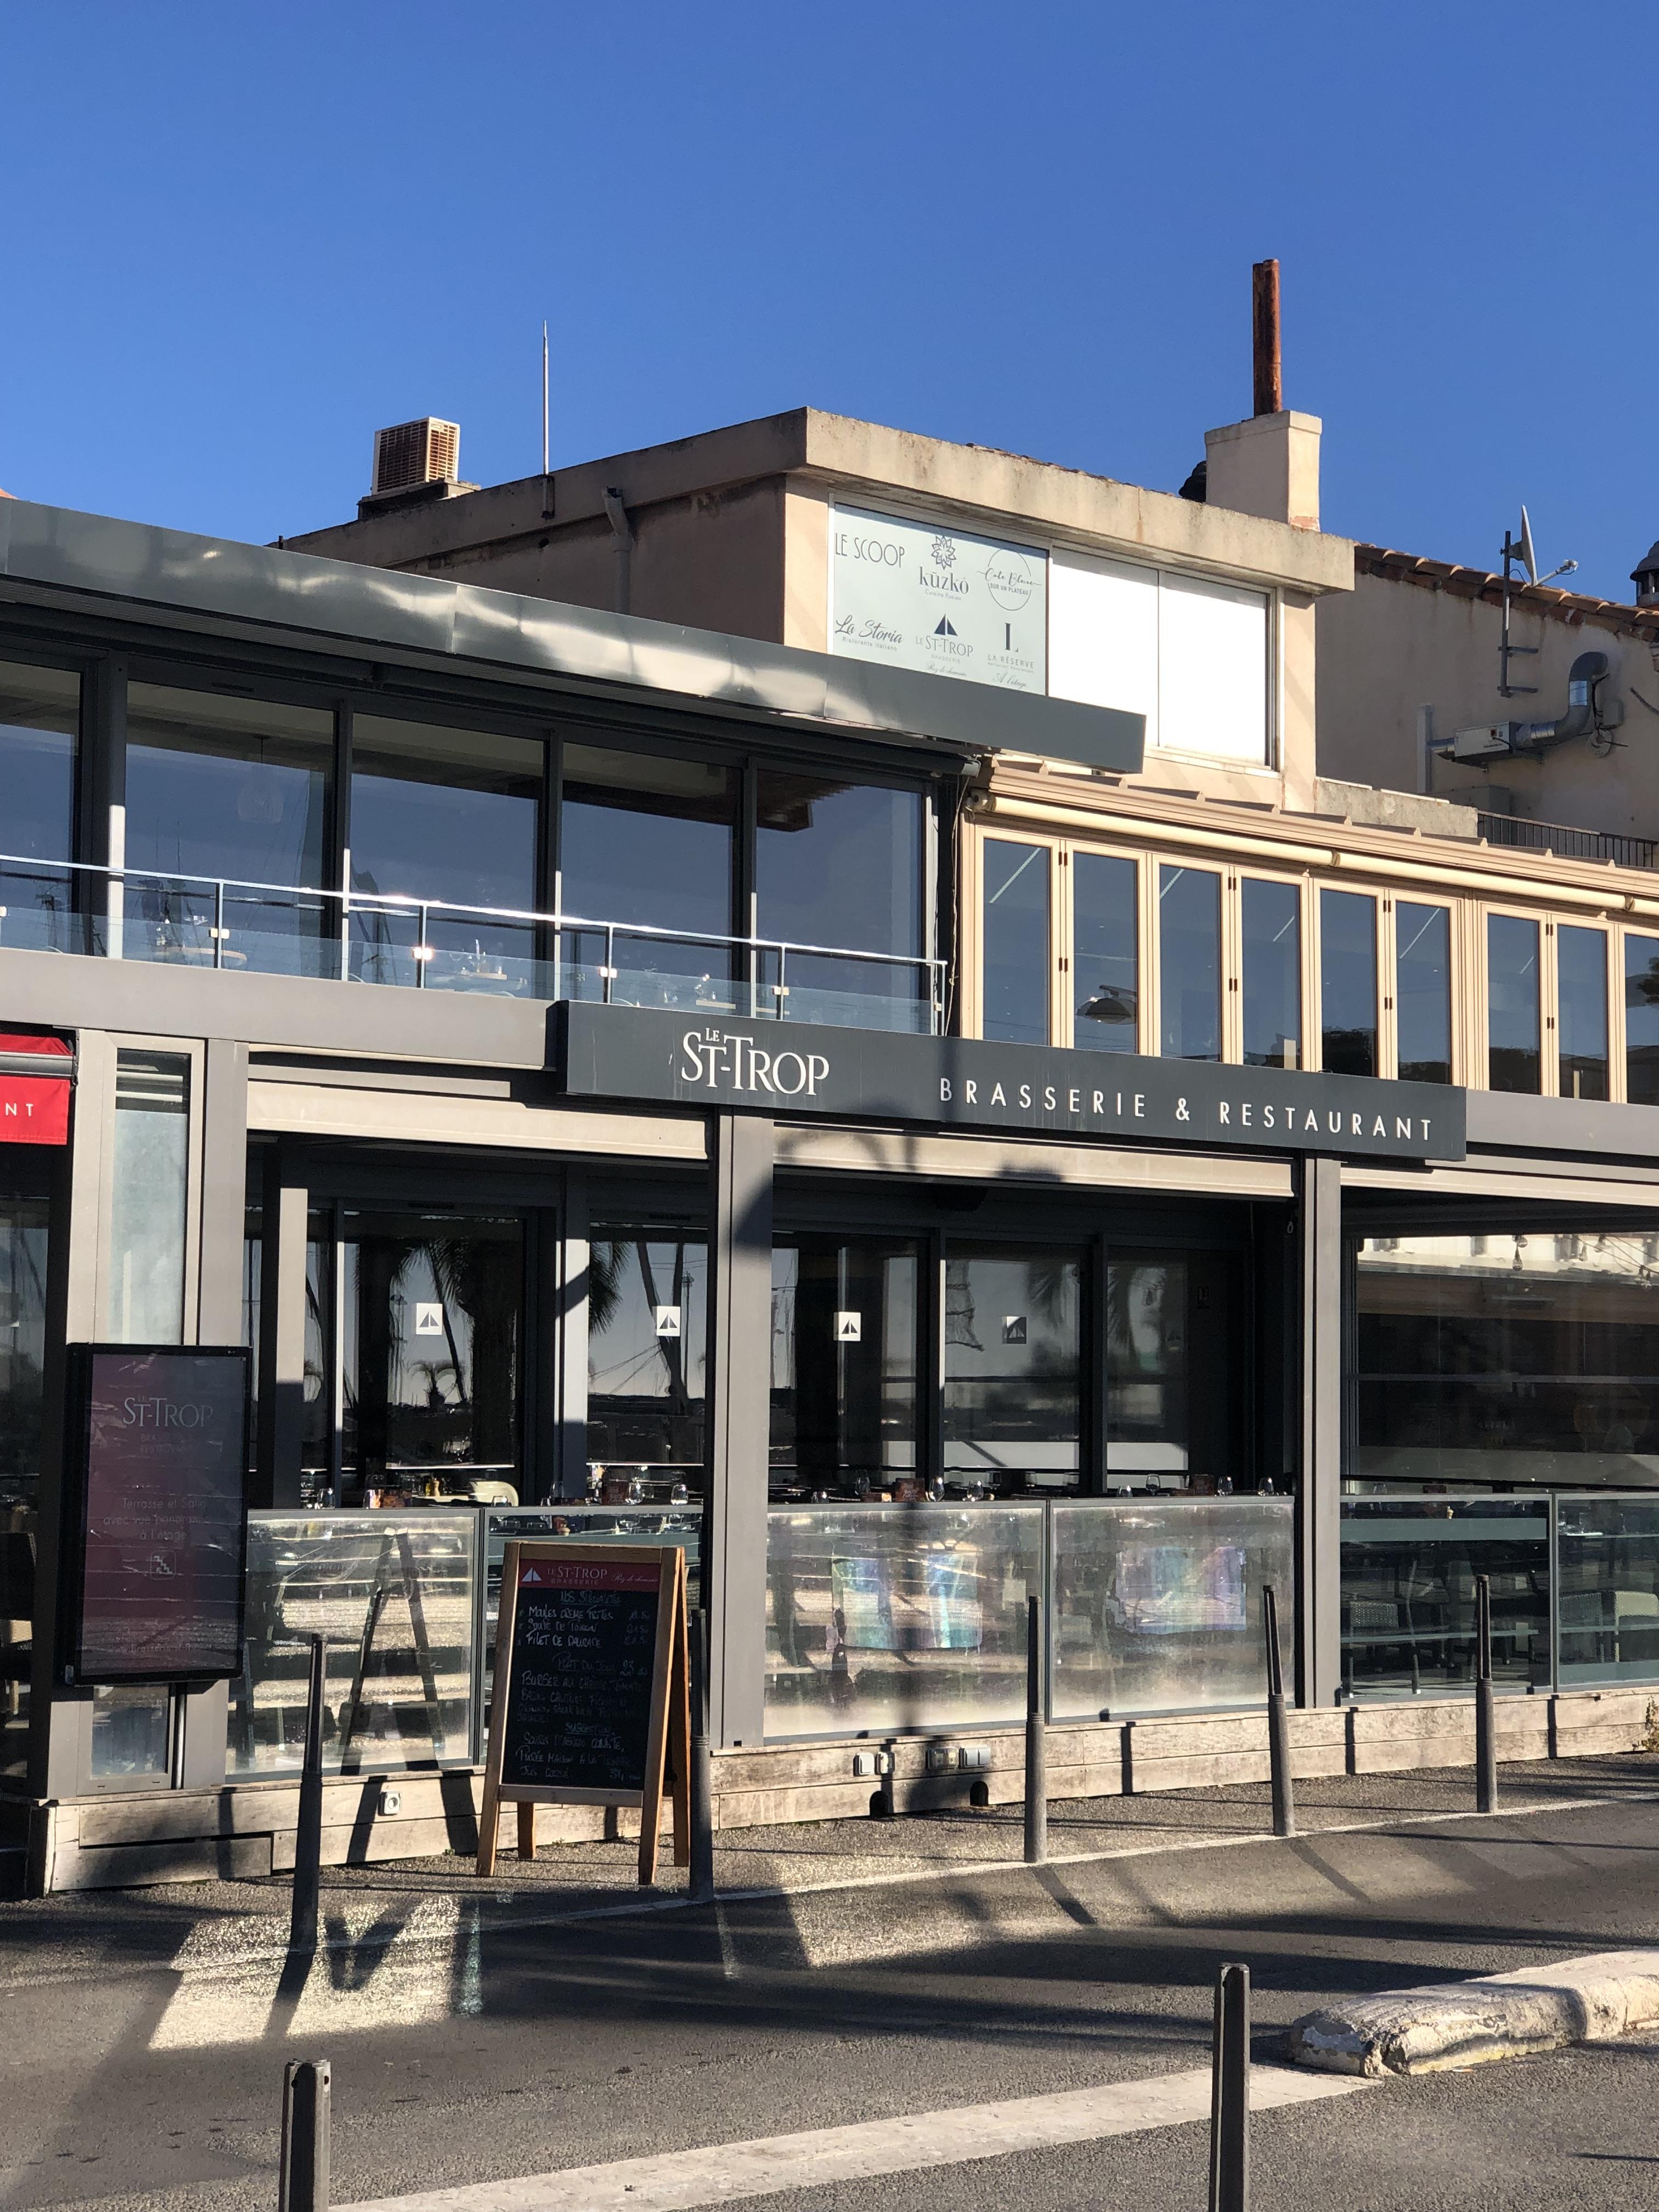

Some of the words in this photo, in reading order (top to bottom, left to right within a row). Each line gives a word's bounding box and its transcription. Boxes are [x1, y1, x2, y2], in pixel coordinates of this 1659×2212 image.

[836, 533, 848, 557] LE
[854, 537, 905, 568] SCOOP
[1008, 586, 1029, 595] PLATEAU
[834, 614, 855, 635] La
[859, 619, 904, 644] Storia
[842, 636, 873, 647] Ristorante
[916, 636, 923, 645] LE
[926, 635, 974, 657] ST-TROP
[988, 653, 997, 662] LA
[1001, 656, 1034, 669] RÉSERVE
[705, 1028, 720, 1042] LE
[681, 1031, 830, 1096] ST-TROP
[940, 1077, 1146, 1118] BRASSERIE
[1175, 1097, 1190, 1121] &
[1220, 1101, 1431, 1141] RESTAURANT
[122, 1498, 163, 1509] Terrasse
